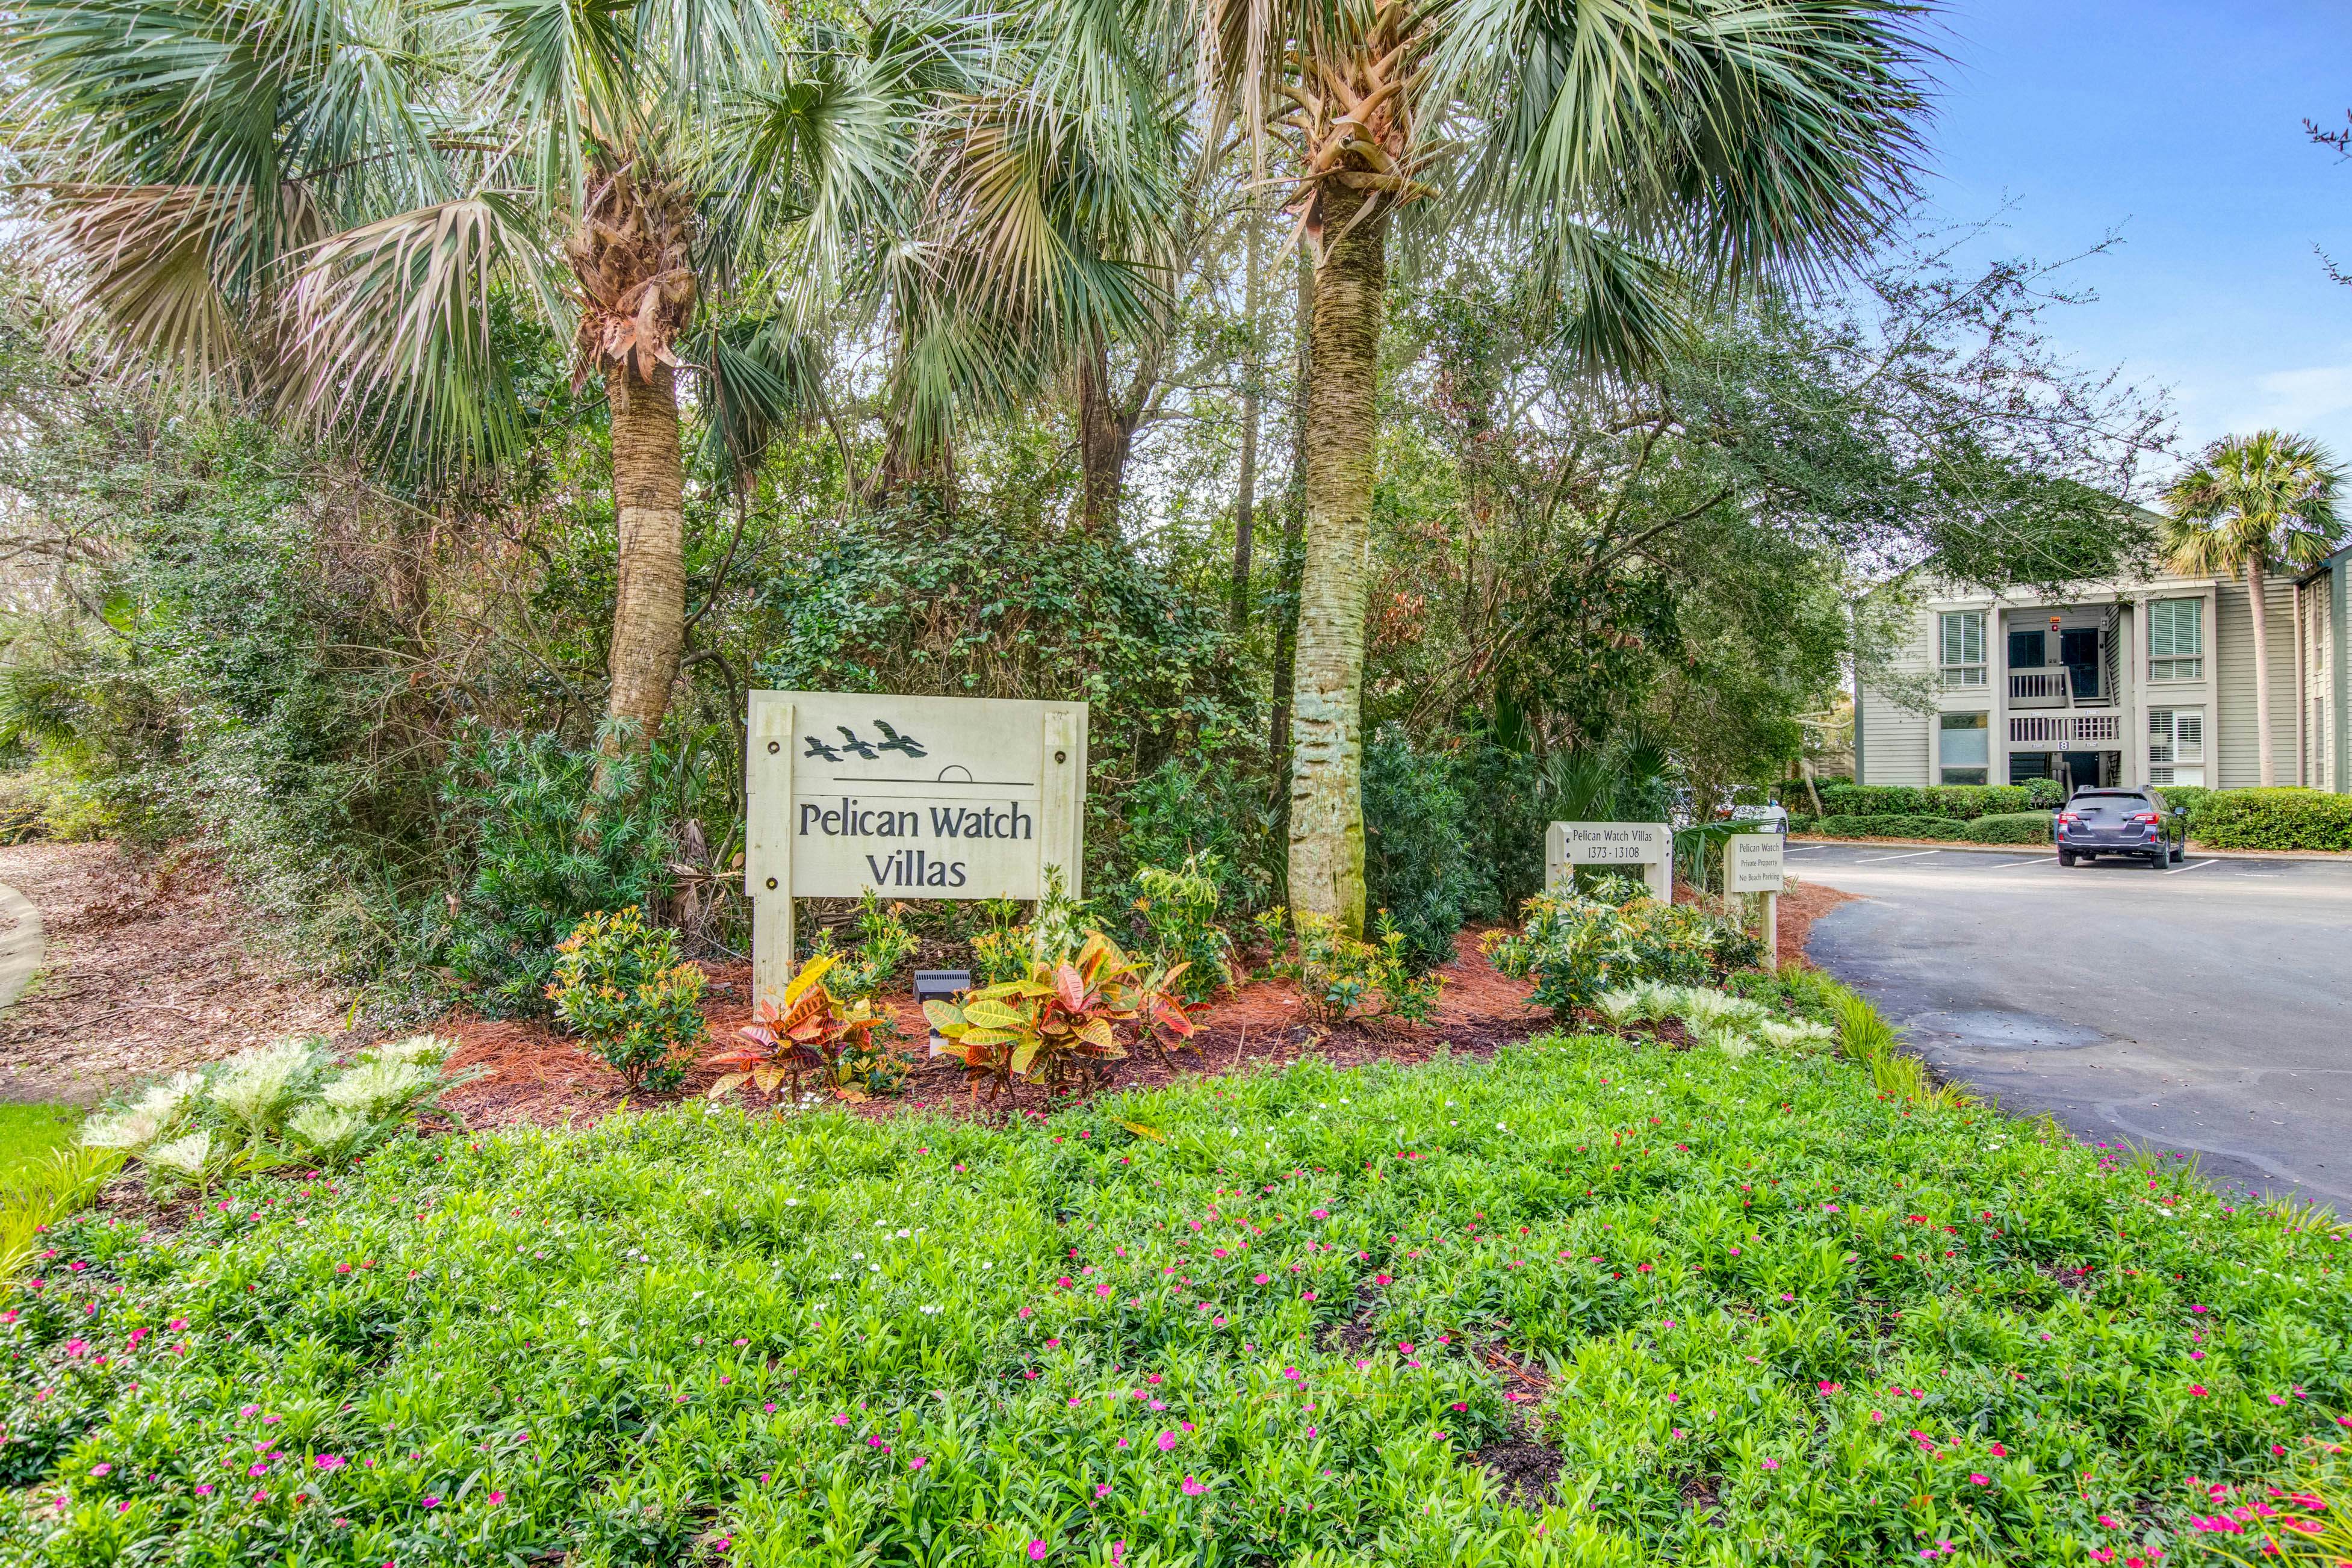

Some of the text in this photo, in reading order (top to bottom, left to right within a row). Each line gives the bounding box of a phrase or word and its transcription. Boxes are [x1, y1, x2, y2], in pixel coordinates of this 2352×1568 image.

[799, 798, 1031, 840] Pelican Watch
[1573, 829, 1652, 841] Pelican Watch Villas
[1588, 847, 1607, 858] 1373
[1615, 847, 1639, 858] 13108
[1739, 843, 1779, 852] Pelican Watch
[866, 849, 966, 887] Villas
